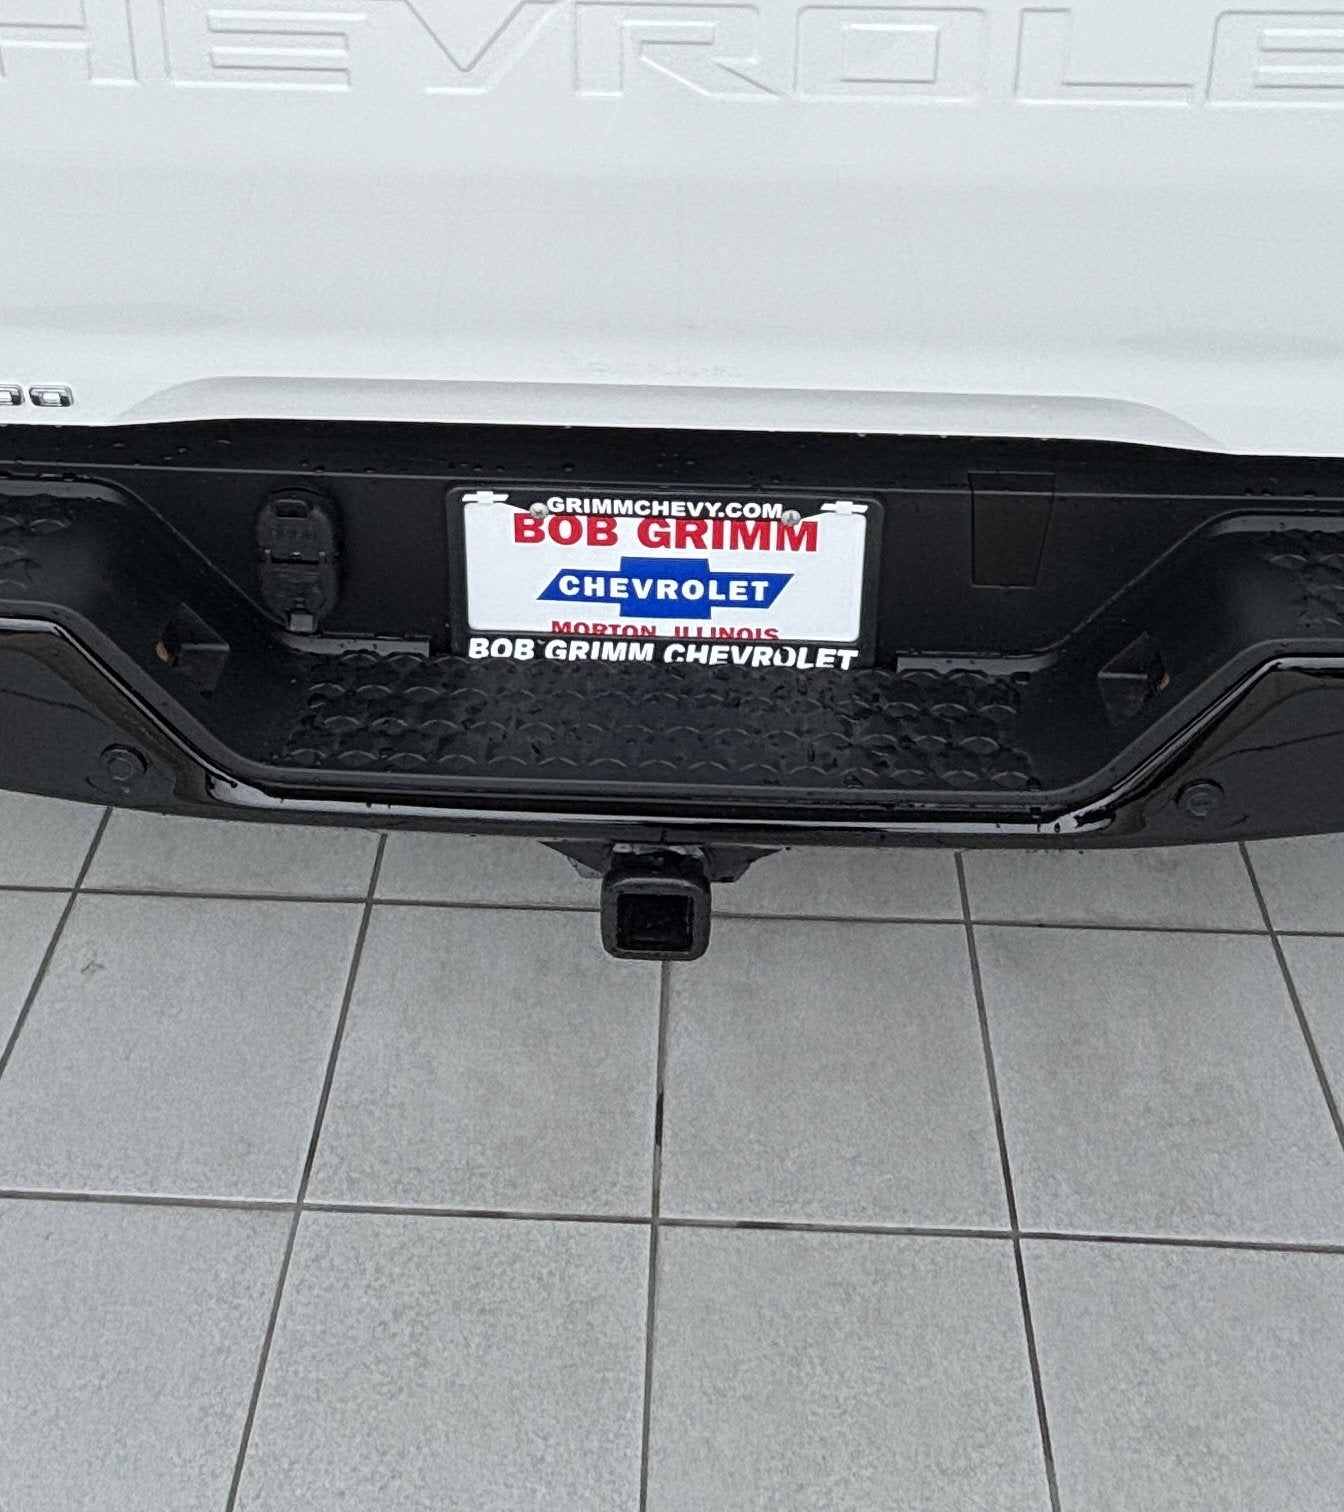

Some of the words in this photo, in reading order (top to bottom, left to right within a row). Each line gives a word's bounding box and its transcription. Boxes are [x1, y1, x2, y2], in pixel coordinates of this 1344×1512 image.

[546, 496, 784, 519] GRIMMCHEVY.COM
[513, 512, 618, 546] BOB
[637, 517, 818, 552] GRIMM
[558, 574, 770, 602] CHEVROLET
[551, 620, 658, 638] MORTON
[674, 625, 780, 641] ILLINOIS
[468, 637, 535, 660] BOB
[543, 639, 655, 663] GRIMM
[663, 642, 859, 671] CHEVROLET
